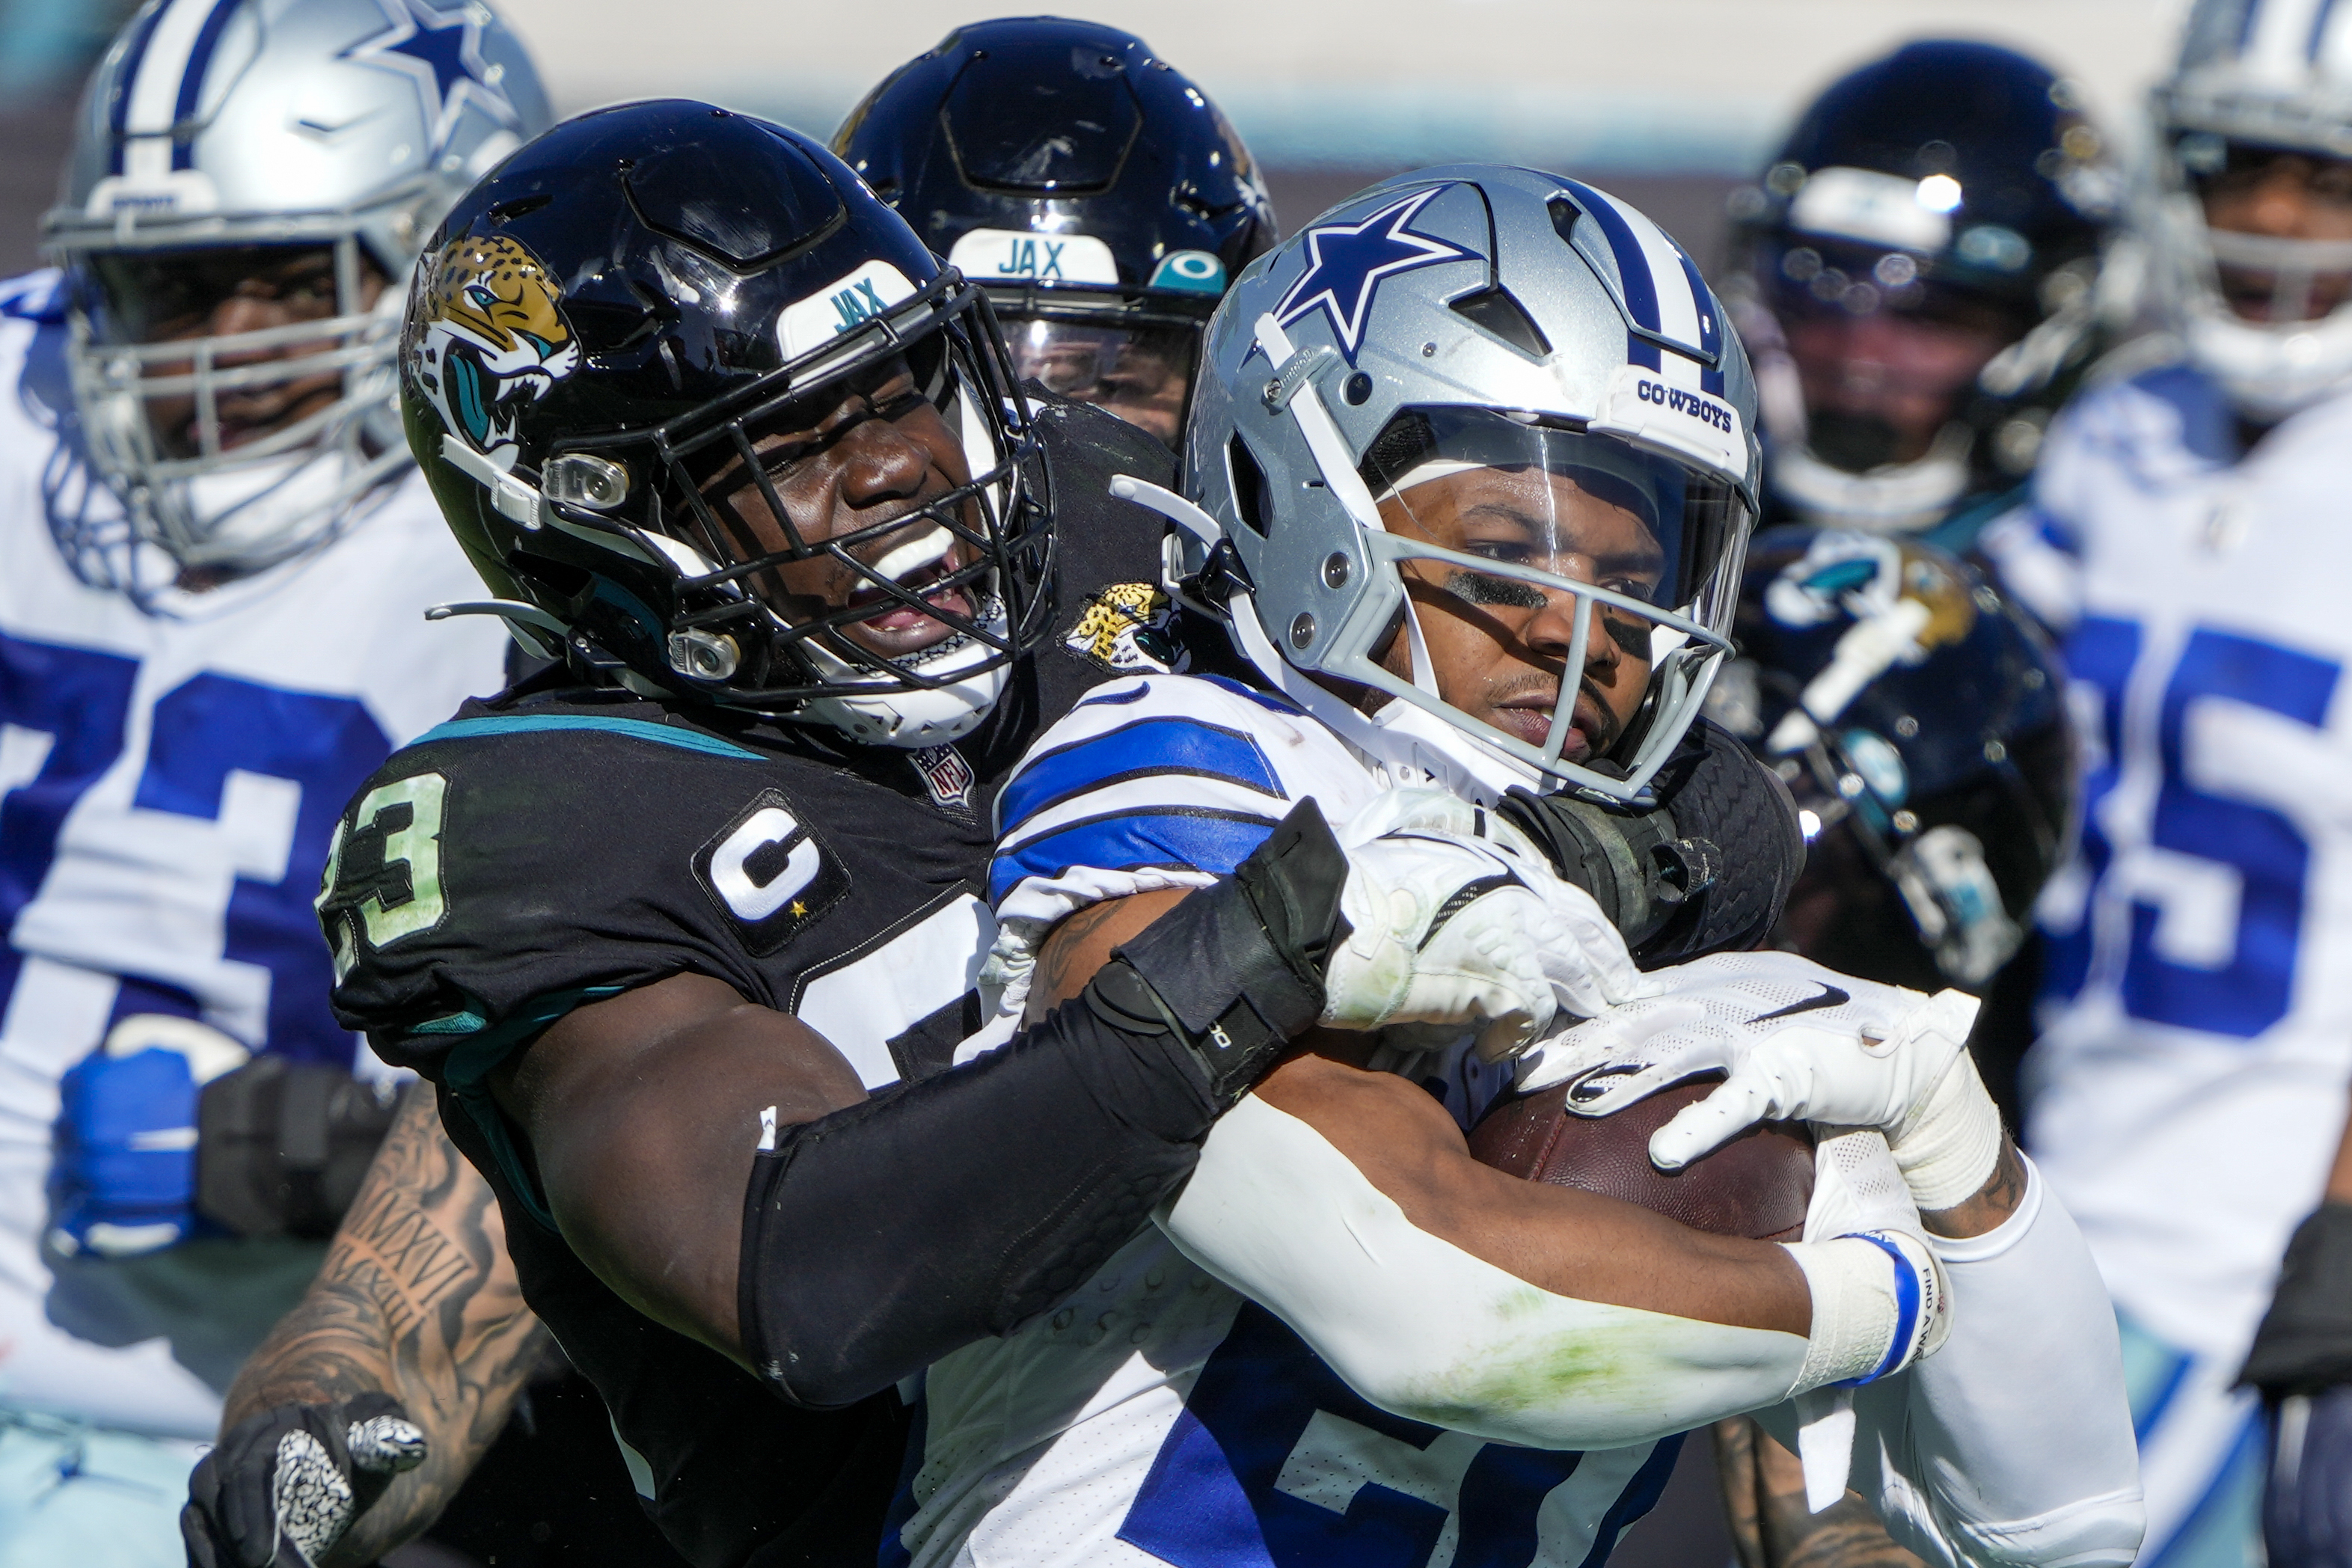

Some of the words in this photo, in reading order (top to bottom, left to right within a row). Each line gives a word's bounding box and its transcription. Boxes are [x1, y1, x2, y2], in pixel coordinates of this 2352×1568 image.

[999, 238, 1065, 279] JAX
[830, 277, 891, 335] JAX
[1638, 379, 1732, 433] COWBOYS
[930, 758, 968, 795] NFL
[313, 771, 447, 989] 3
[710, 807, 820, 921] C
[1923, 1267, 1933, 1310] FIND
[1923, 1315, 1931, 1328] A
